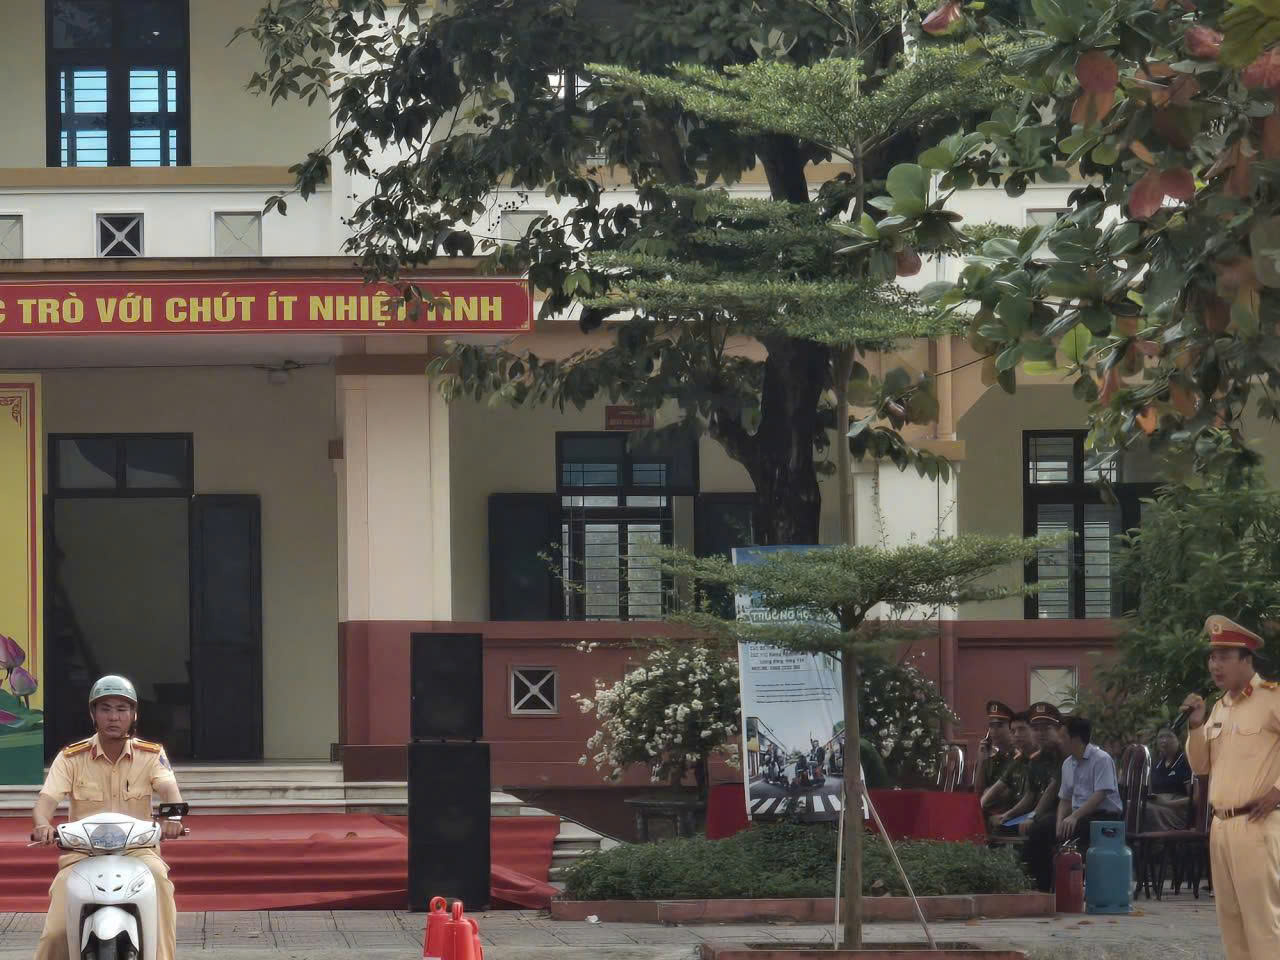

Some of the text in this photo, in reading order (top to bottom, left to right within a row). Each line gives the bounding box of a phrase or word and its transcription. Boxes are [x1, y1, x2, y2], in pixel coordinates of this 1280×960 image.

[17, 291, 85, 325] TRÒ
[96, 292, 153, 323] VỚI
[165, 291, 255, 323] CHÚT
[268, 290, 298, 321] ÍT
